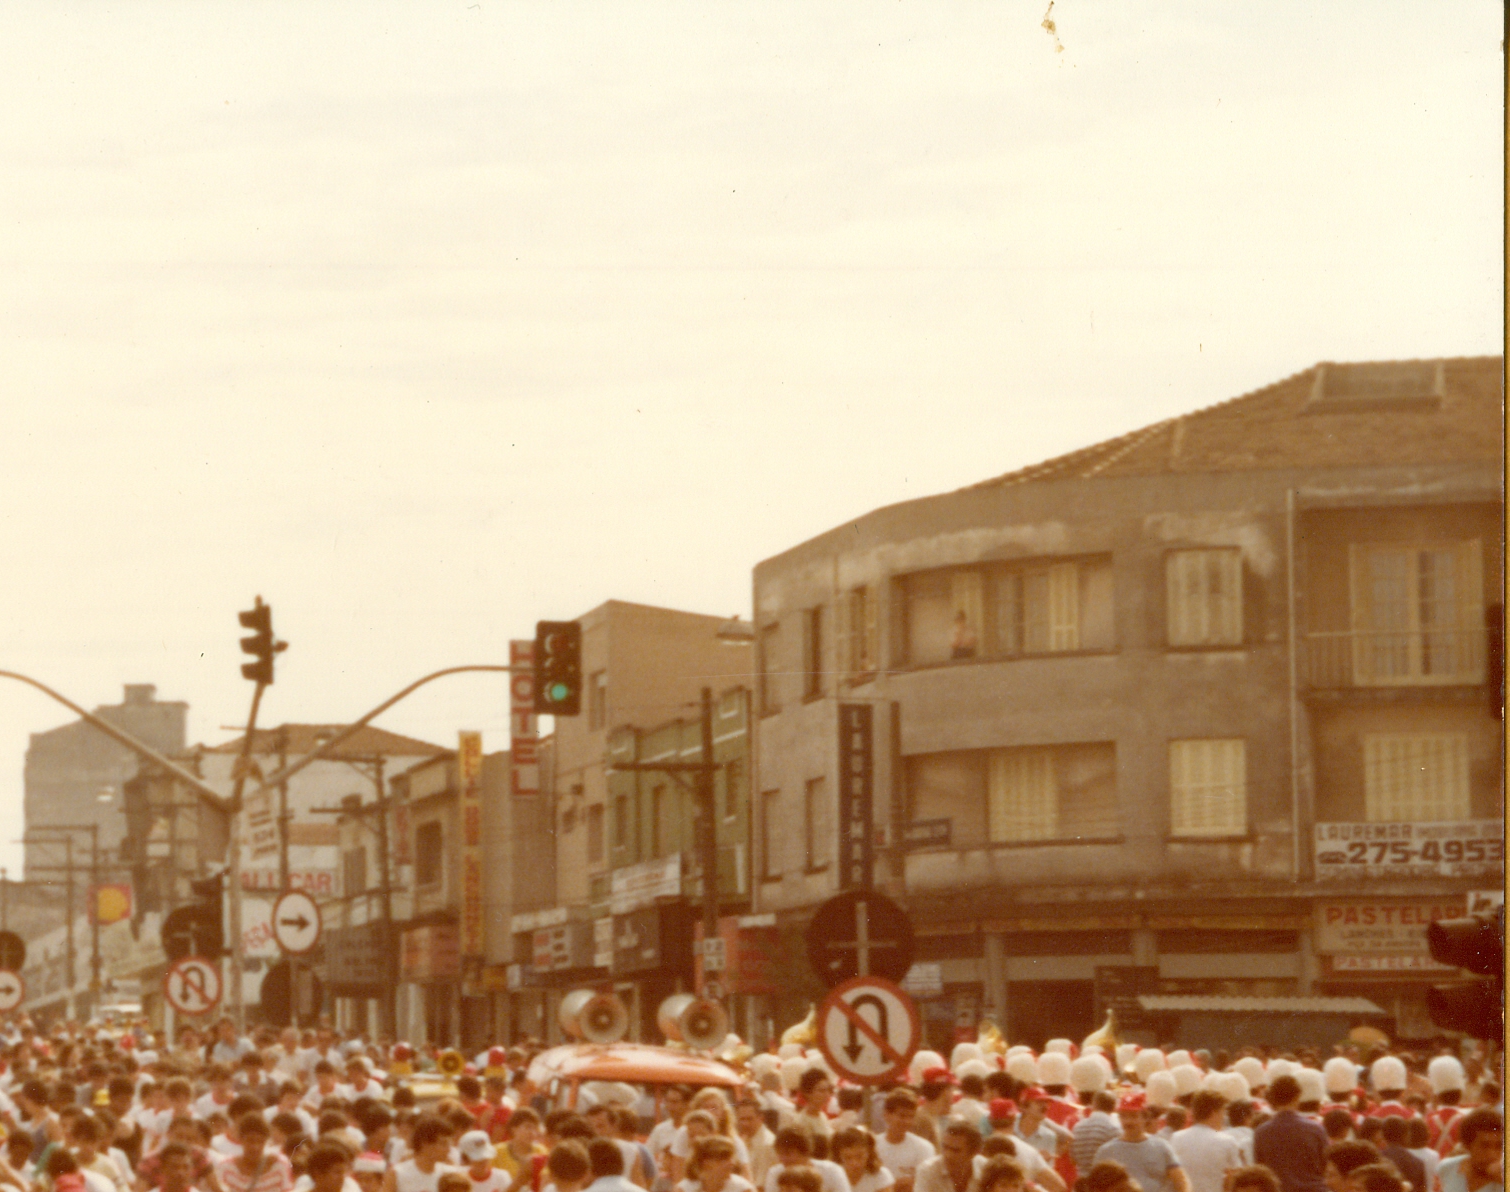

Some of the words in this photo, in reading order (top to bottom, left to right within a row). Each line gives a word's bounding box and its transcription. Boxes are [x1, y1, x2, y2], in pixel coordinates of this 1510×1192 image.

[510, 640, 539, 796] HOTEL
[850, 710, 864, 883] LAUREMAR
[1317, 823, 1413, 841] LAUREMAR
[1347, 838, 1504, 865] 275-4953
